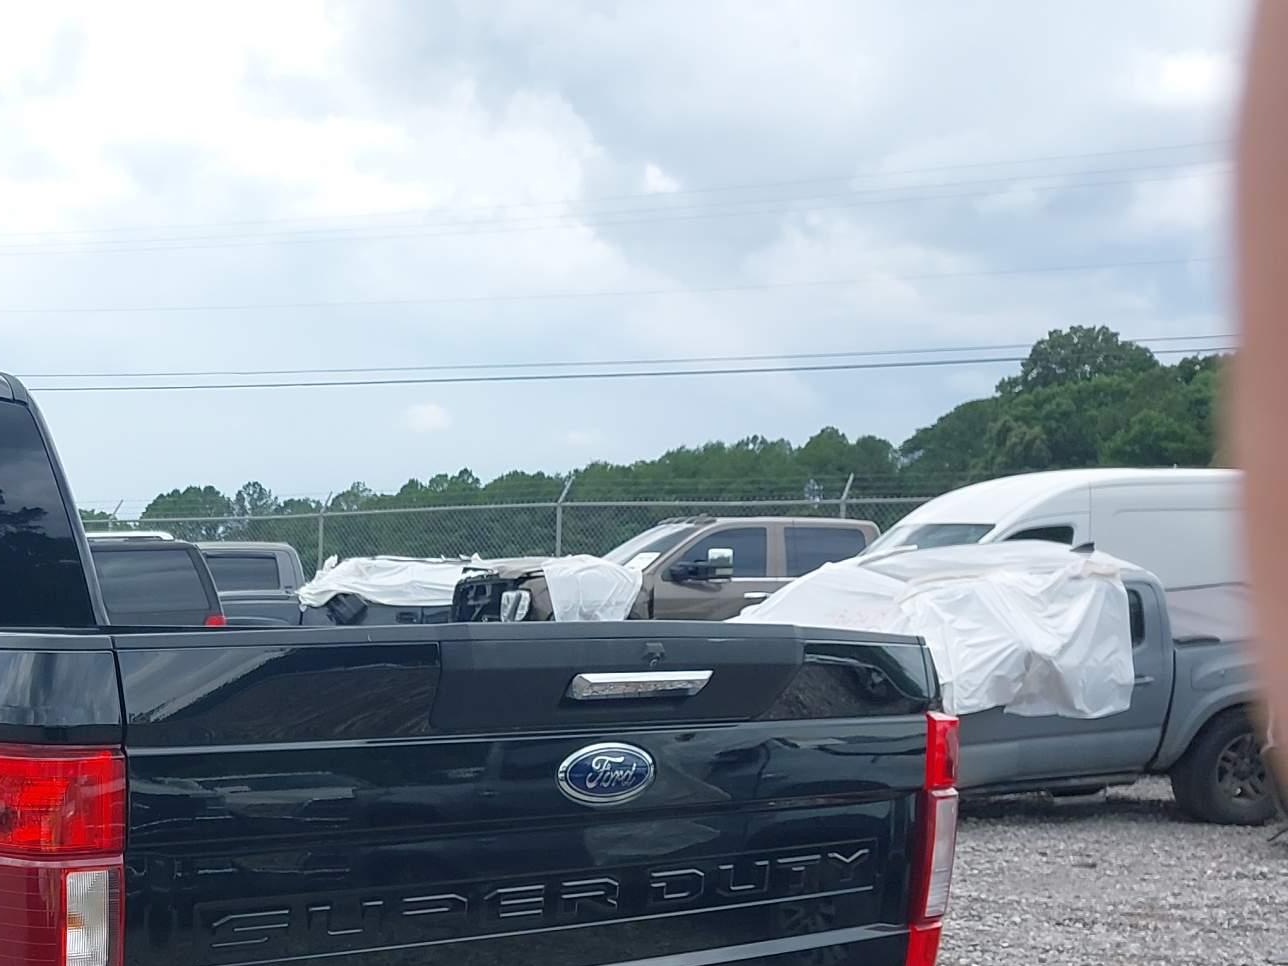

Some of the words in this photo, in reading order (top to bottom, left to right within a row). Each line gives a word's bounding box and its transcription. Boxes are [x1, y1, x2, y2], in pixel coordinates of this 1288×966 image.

[585, 755, 637, 789] Ford
[210, 877, 620, 949] SUPER
[650, 848, 870, 899] DUTY
